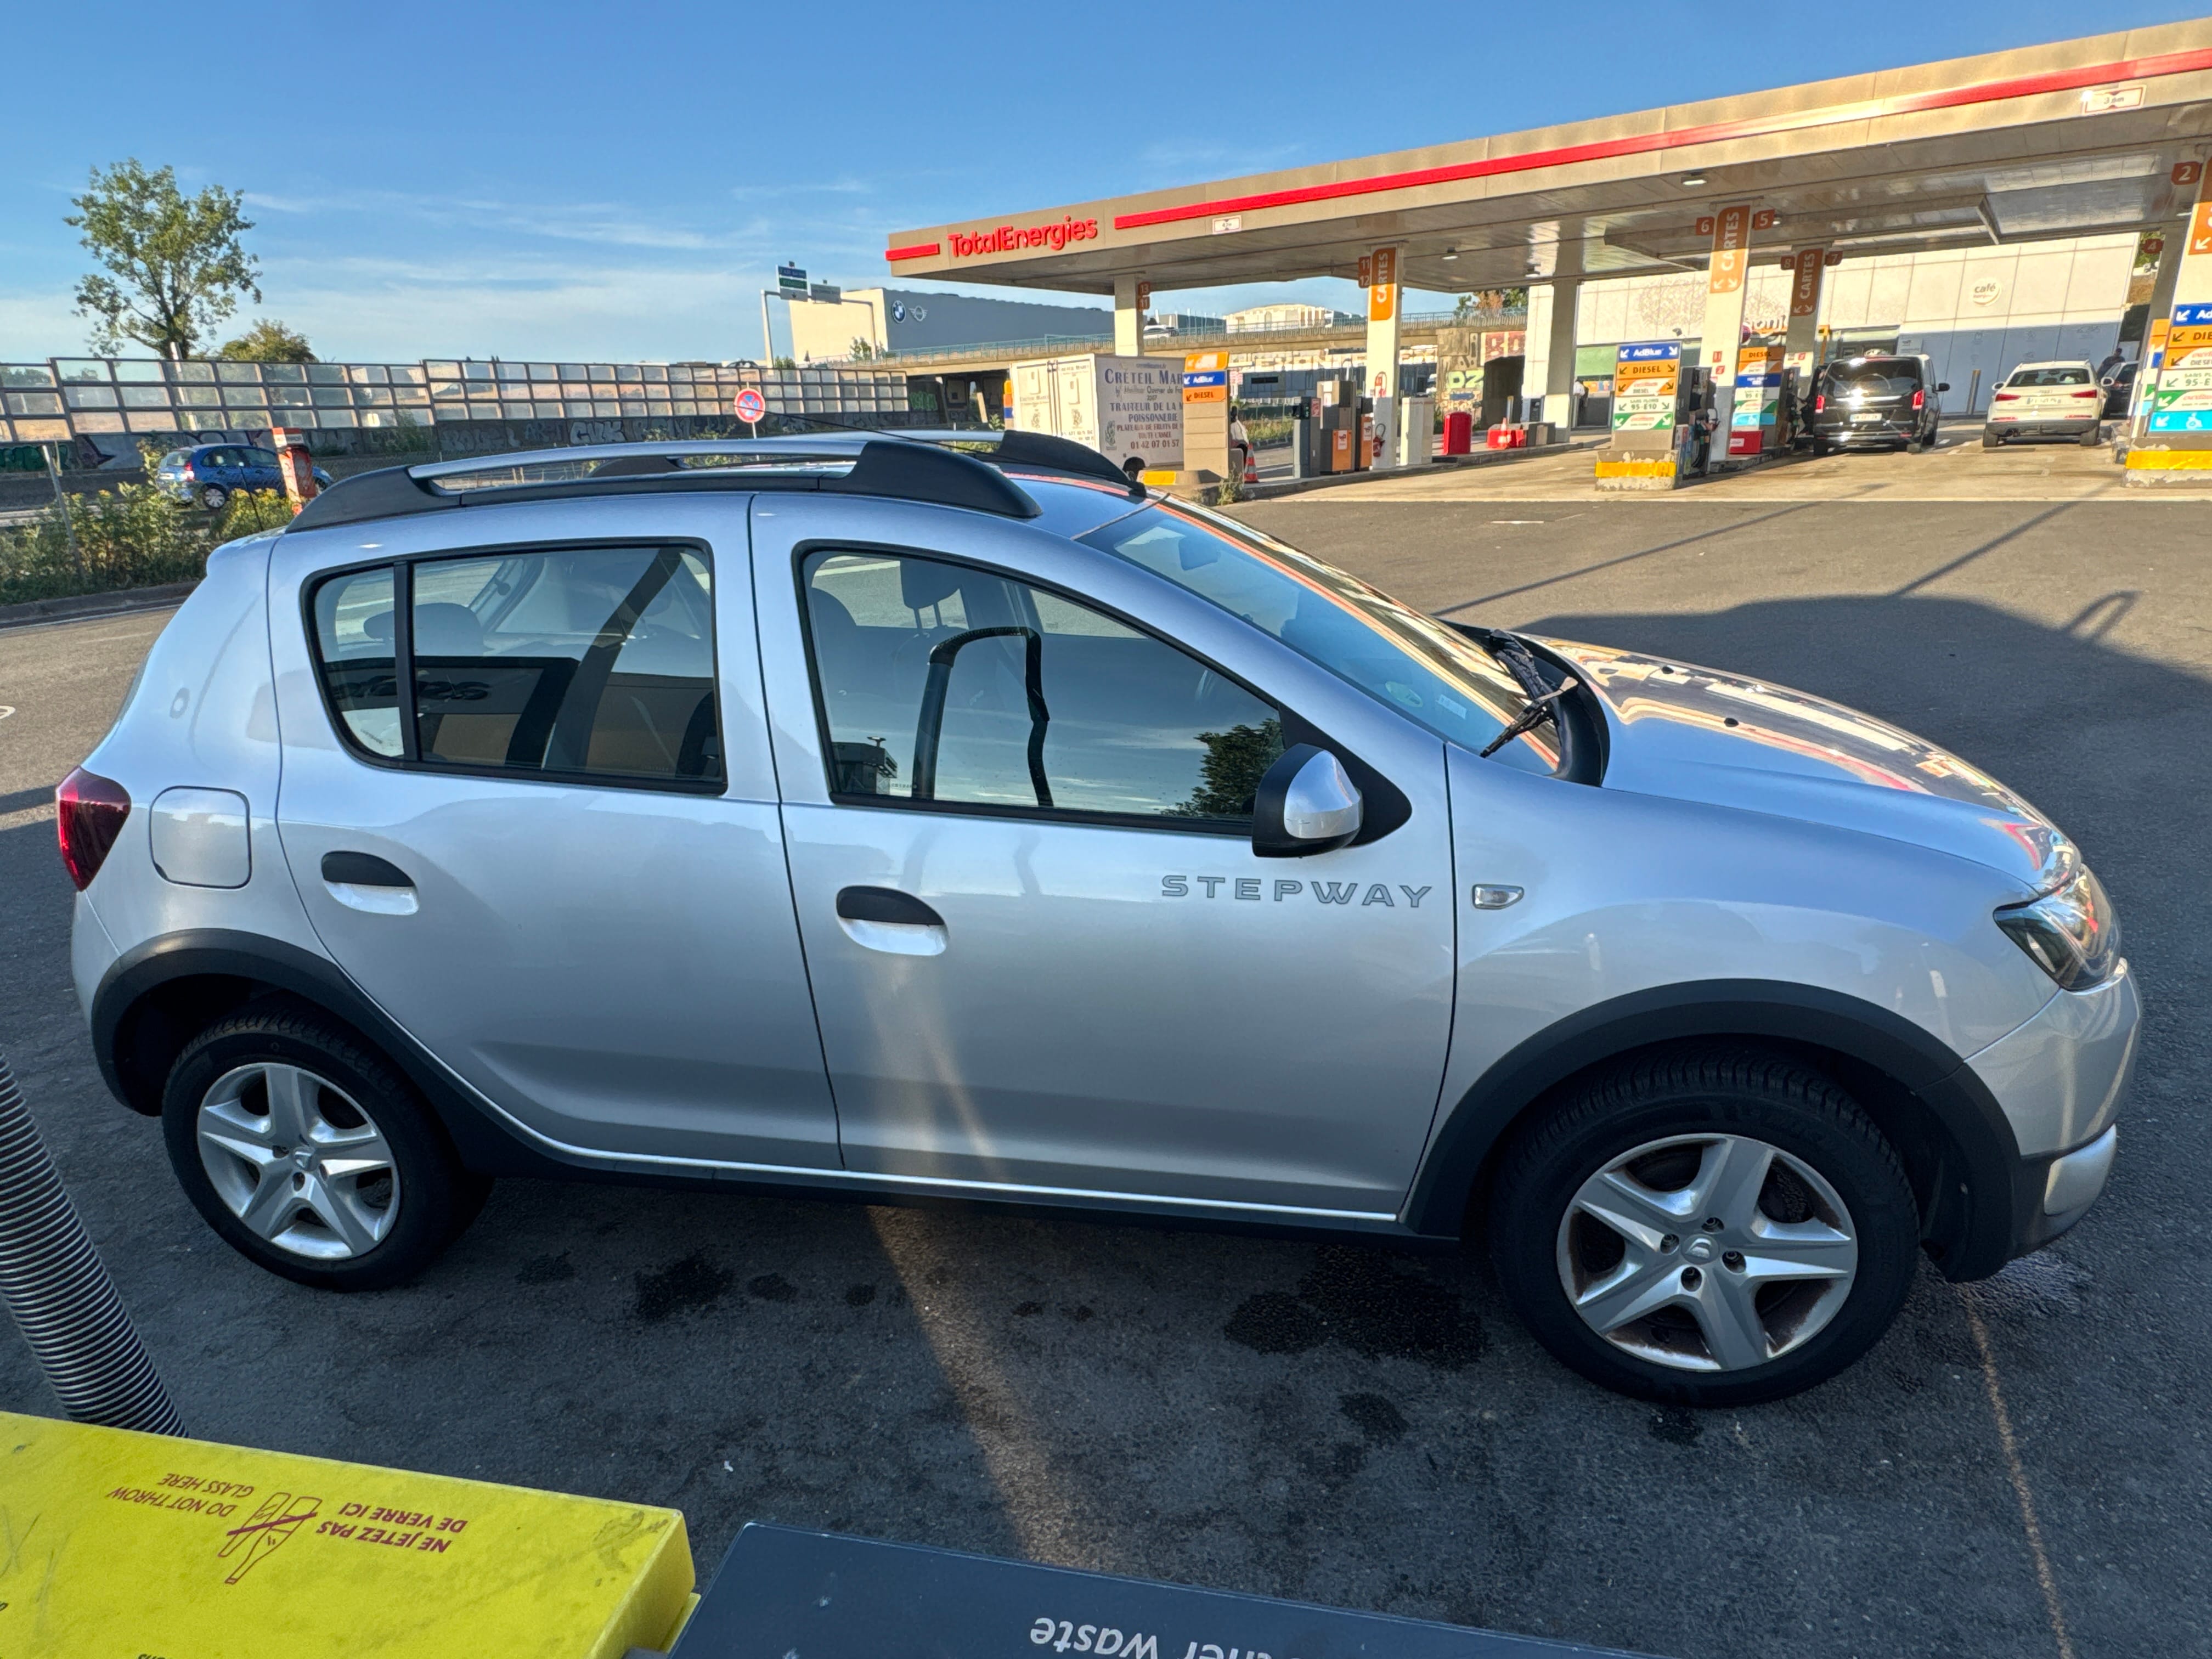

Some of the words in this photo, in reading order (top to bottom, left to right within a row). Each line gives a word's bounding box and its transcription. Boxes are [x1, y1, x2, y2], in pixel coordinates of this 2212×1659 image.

[2179, 165, 2192, 182] 2
[1701, 220, 1709, 233] 6
[1759, 213, 1769, 227] 5
[947, 215, 1098, 257] TotalEnergies
[1721, 211, 1740, 271] CARTES
[2147, 241, 2157, 250] 4
[1361, 259, 1370, 269] 11
[1784, 258, 1791, 268] 8
[1831, 254, 1838, 264] 7
[1360, 276, 1370, 286] 12
[1376, 252, 1389, 303] CARTES
[1799, 252, 1815, 300] CARTES
[1974, 282, 1996, 293] café
[2193, 331, 2212, 341] DIE
[1633, 348, 1663, 357] AdBlue
[1159, 370, 1183, 385] MAR
[2185, 378, 2212, 386] 95-E
[1110, 402, 1151, 412] TRAITEUR
[1153, 402, 1164, 411] DE
[1167, 402, 1177, 411] LA
[1128, 413, 1178, 423] POISSONNERIE
[1130, 441, 1139, 449] 01
[1141, 441, 1149, 449] 42
[1162, 440, 1170, 448] 01
[1161, 874, 1432, 908] STEPWAY
[157, 1472, 207, 1491] HERE
[201, 1480, 255, 1498] GLASS
[106, 1486, 171, 1506] THROW
[165, 1496, 210, 1513] NOT
[206, 1502, 238, 1517] DO
[338, 1502, 371, 1518] ICI
[368, 1506, 433, 1528] VERRE
[436, 1517, 468, 1533] DE
[315, 1520, 358, 1538] PAS
[355, 1526, 424, 1548] JETEZ
[417, 1536, 453, 1553] NE
[1030, 1617, 1158, 1659] waste
